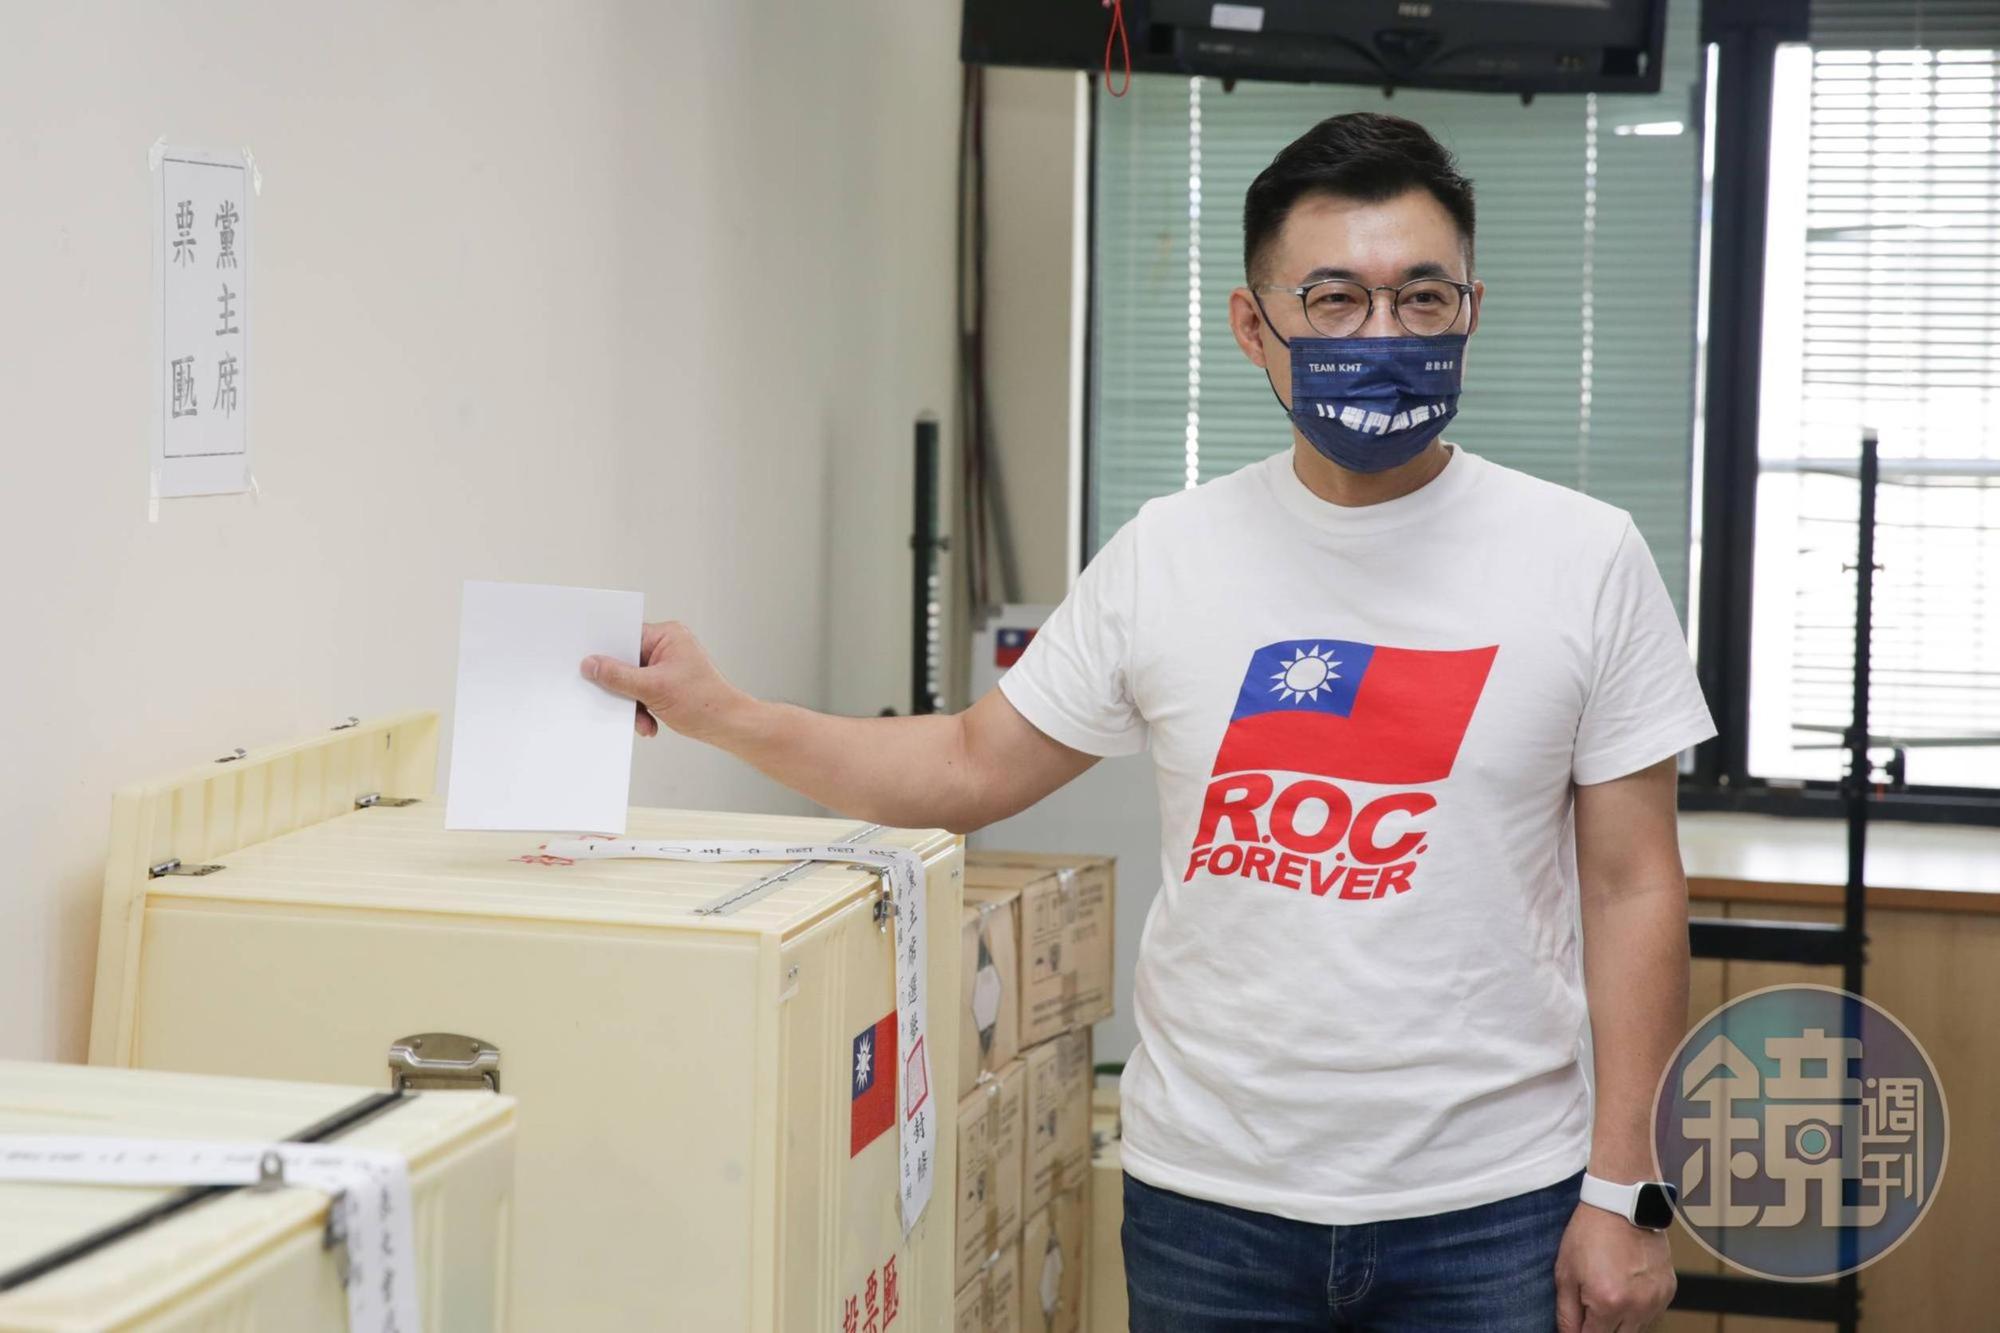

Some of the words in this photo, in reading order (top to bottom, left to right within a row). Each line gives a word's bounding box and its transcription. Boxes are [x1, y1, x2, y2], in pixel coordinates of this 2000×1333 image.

[171, 199, 198, 419] 票匭
[213, 199, 240, 420] 黨主席
[1309, 363, 1336, 373] TEAM
[1338, 363, 1362, 373] KMT
[1192, 774, 1437, 865] R.O.C.
[1183, 842, 1417, 901] FOREVER
